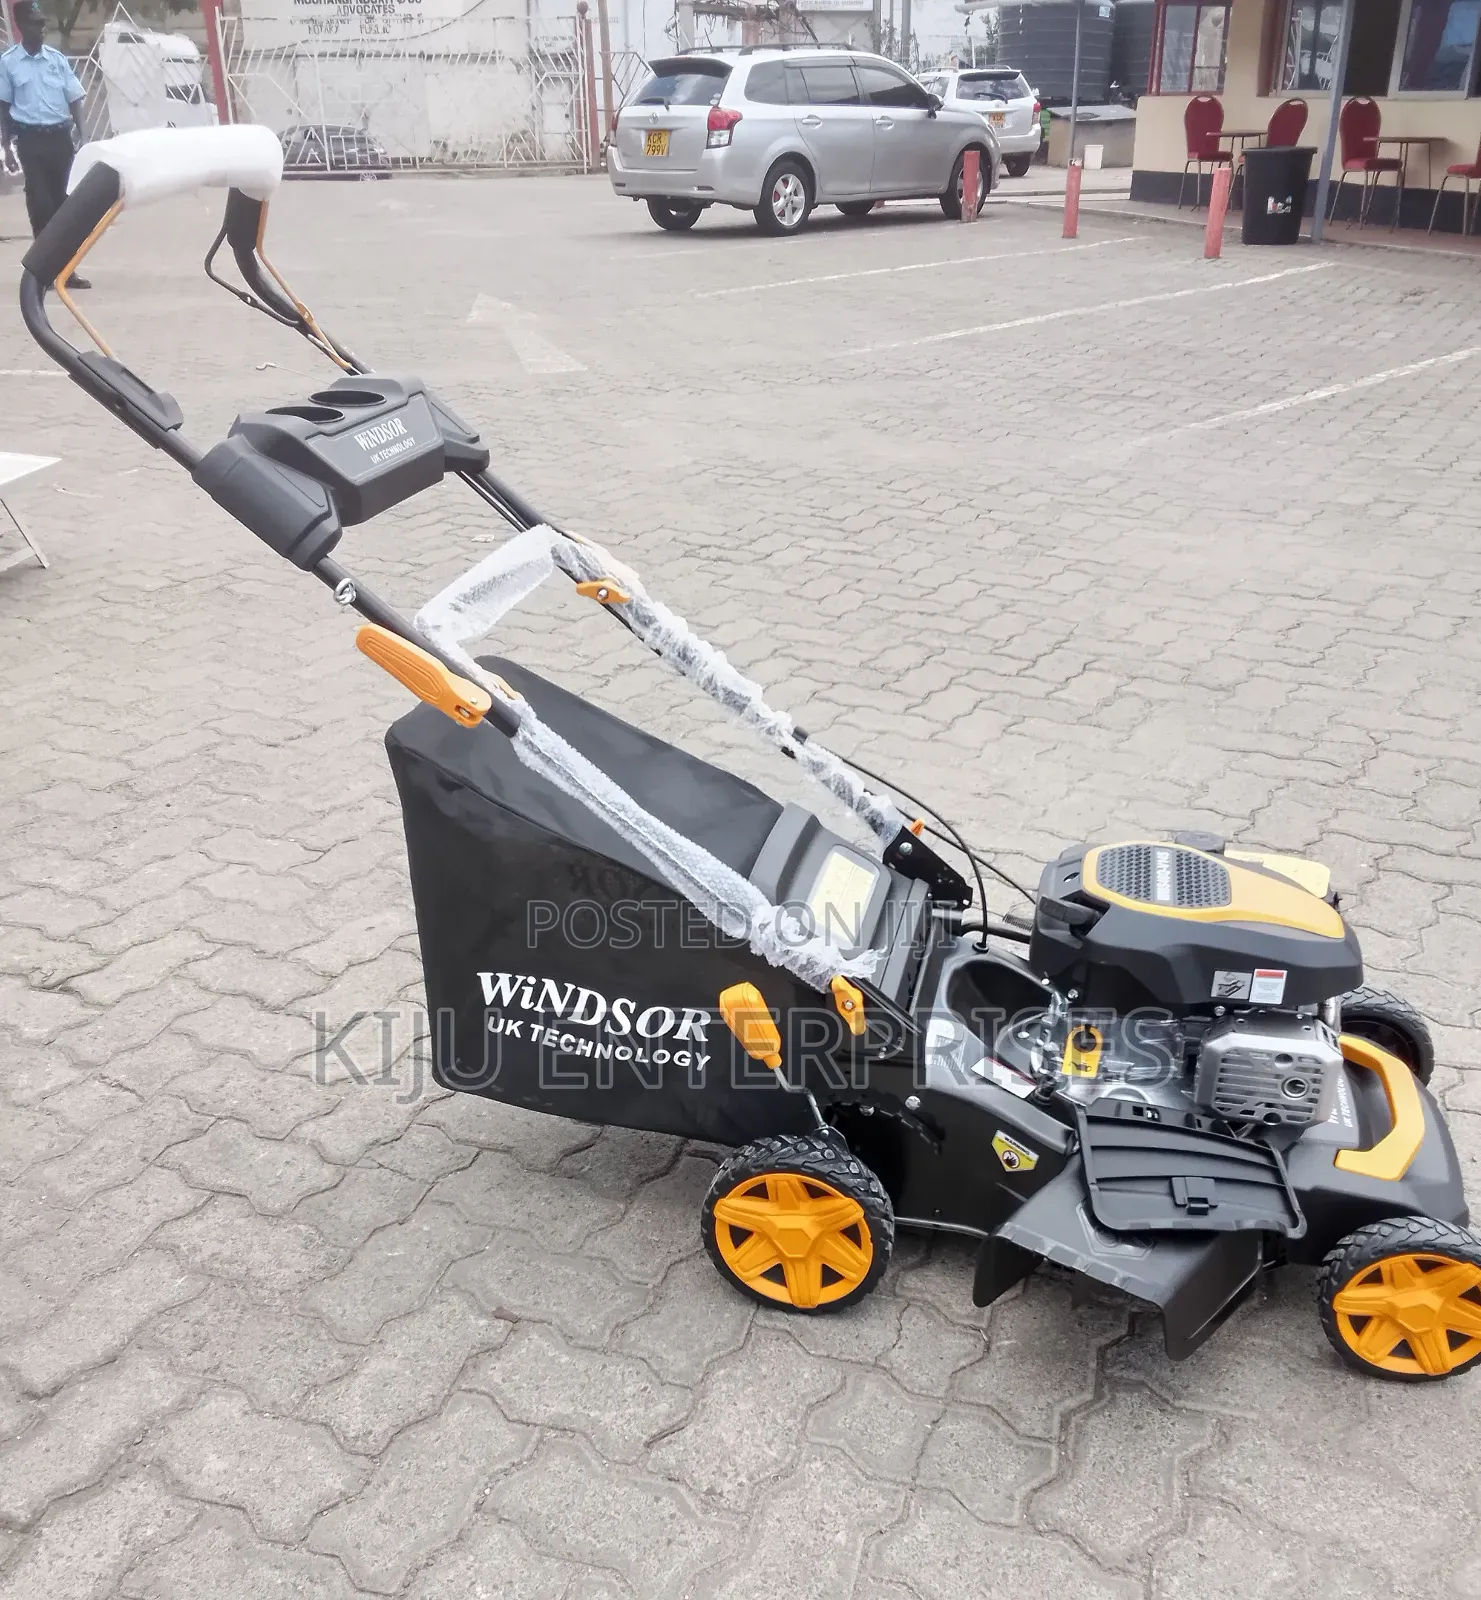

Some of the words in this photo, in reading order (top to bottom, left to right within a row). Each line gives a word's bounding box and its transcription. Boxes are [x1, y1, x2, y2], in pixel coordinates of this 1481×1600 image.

[336, 4, 396, 14] ADVOCATES
[647, 132, 662, 144] KCR
[370, 452, 382, 464] UK
[379, 436, 416, 459] TECHNOLOGY
[487, 1016, 524, 1038] UK
[530, 1023, 712, 1072] TECHNOLOGY
